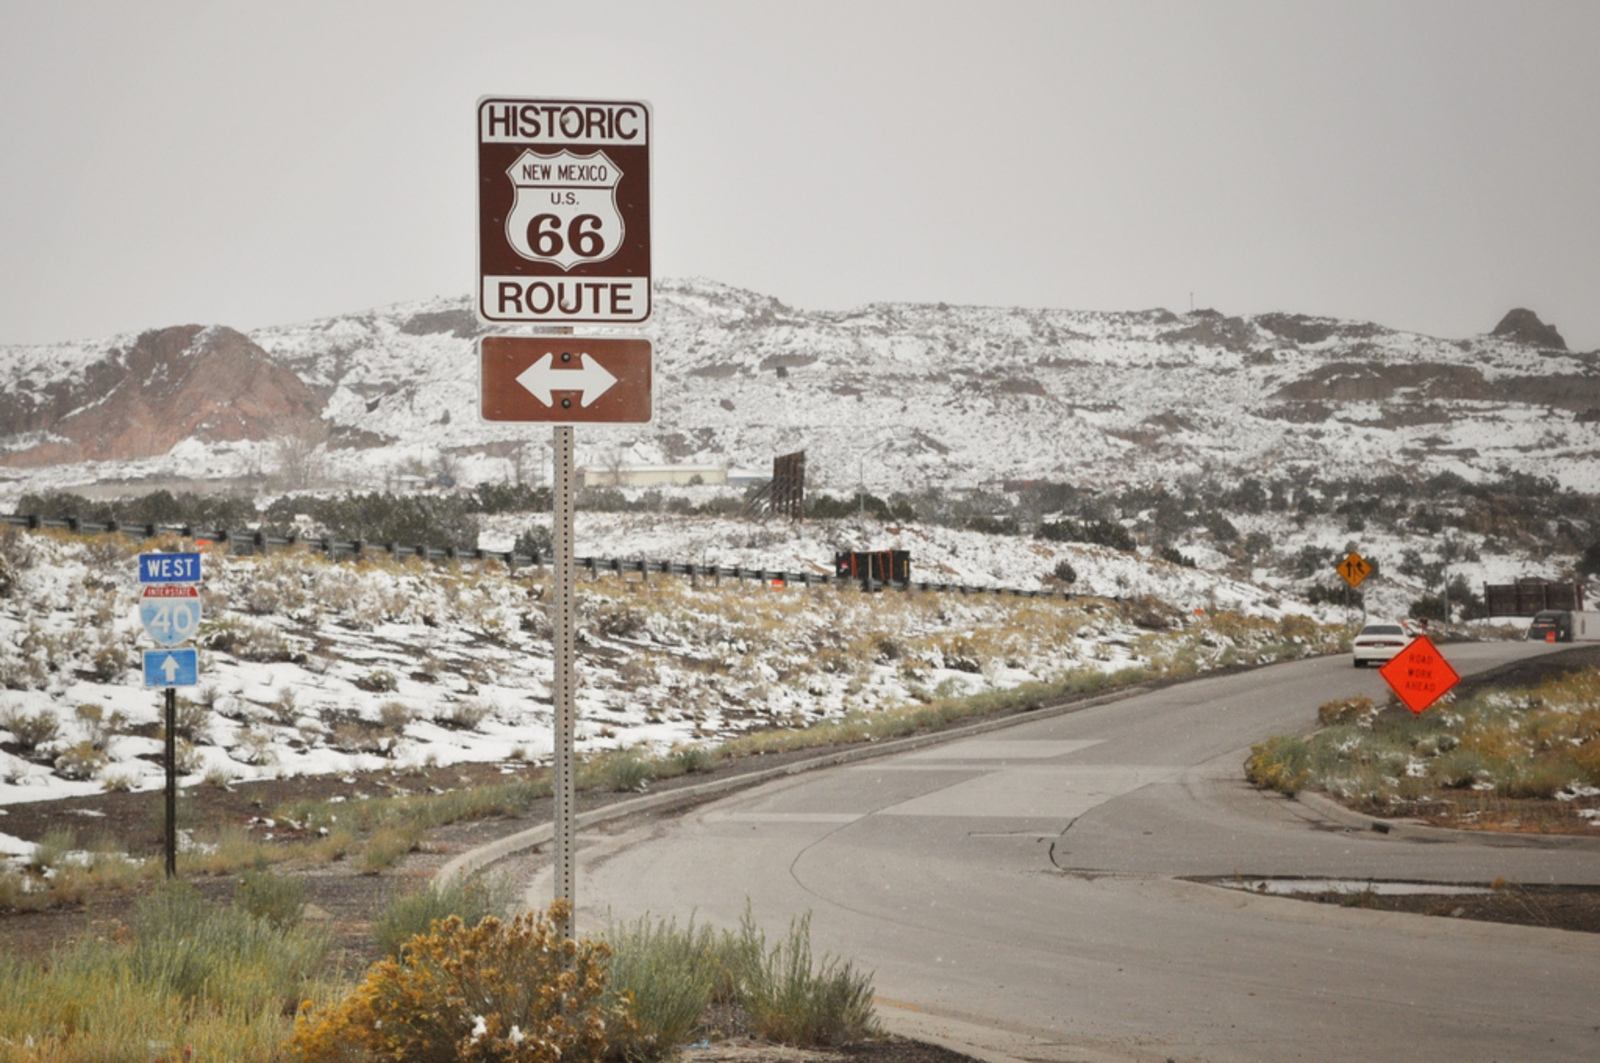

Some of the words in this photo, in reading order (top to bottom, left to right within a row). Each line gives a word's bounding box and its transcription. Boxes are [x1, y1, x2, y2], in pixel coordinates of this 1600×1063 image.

[488, 105, 639, 140] HISTORIC
[522, 164, 552, 181] NEW
[558, 165, 608, 182] MEXICO
[550, 192, 580, 205] U.S.
[526, 214, 605, 257] 66
[498, 281, 633, 315] ROUTE
[147, 558, 194, 577] WEST
[150, 604, 193, 634] 40
[1408, 654, 1434, 664] ROAD
[1407, 669, 1432, 678] WORK
[1406, 681, 1436, 692] AHEAD
